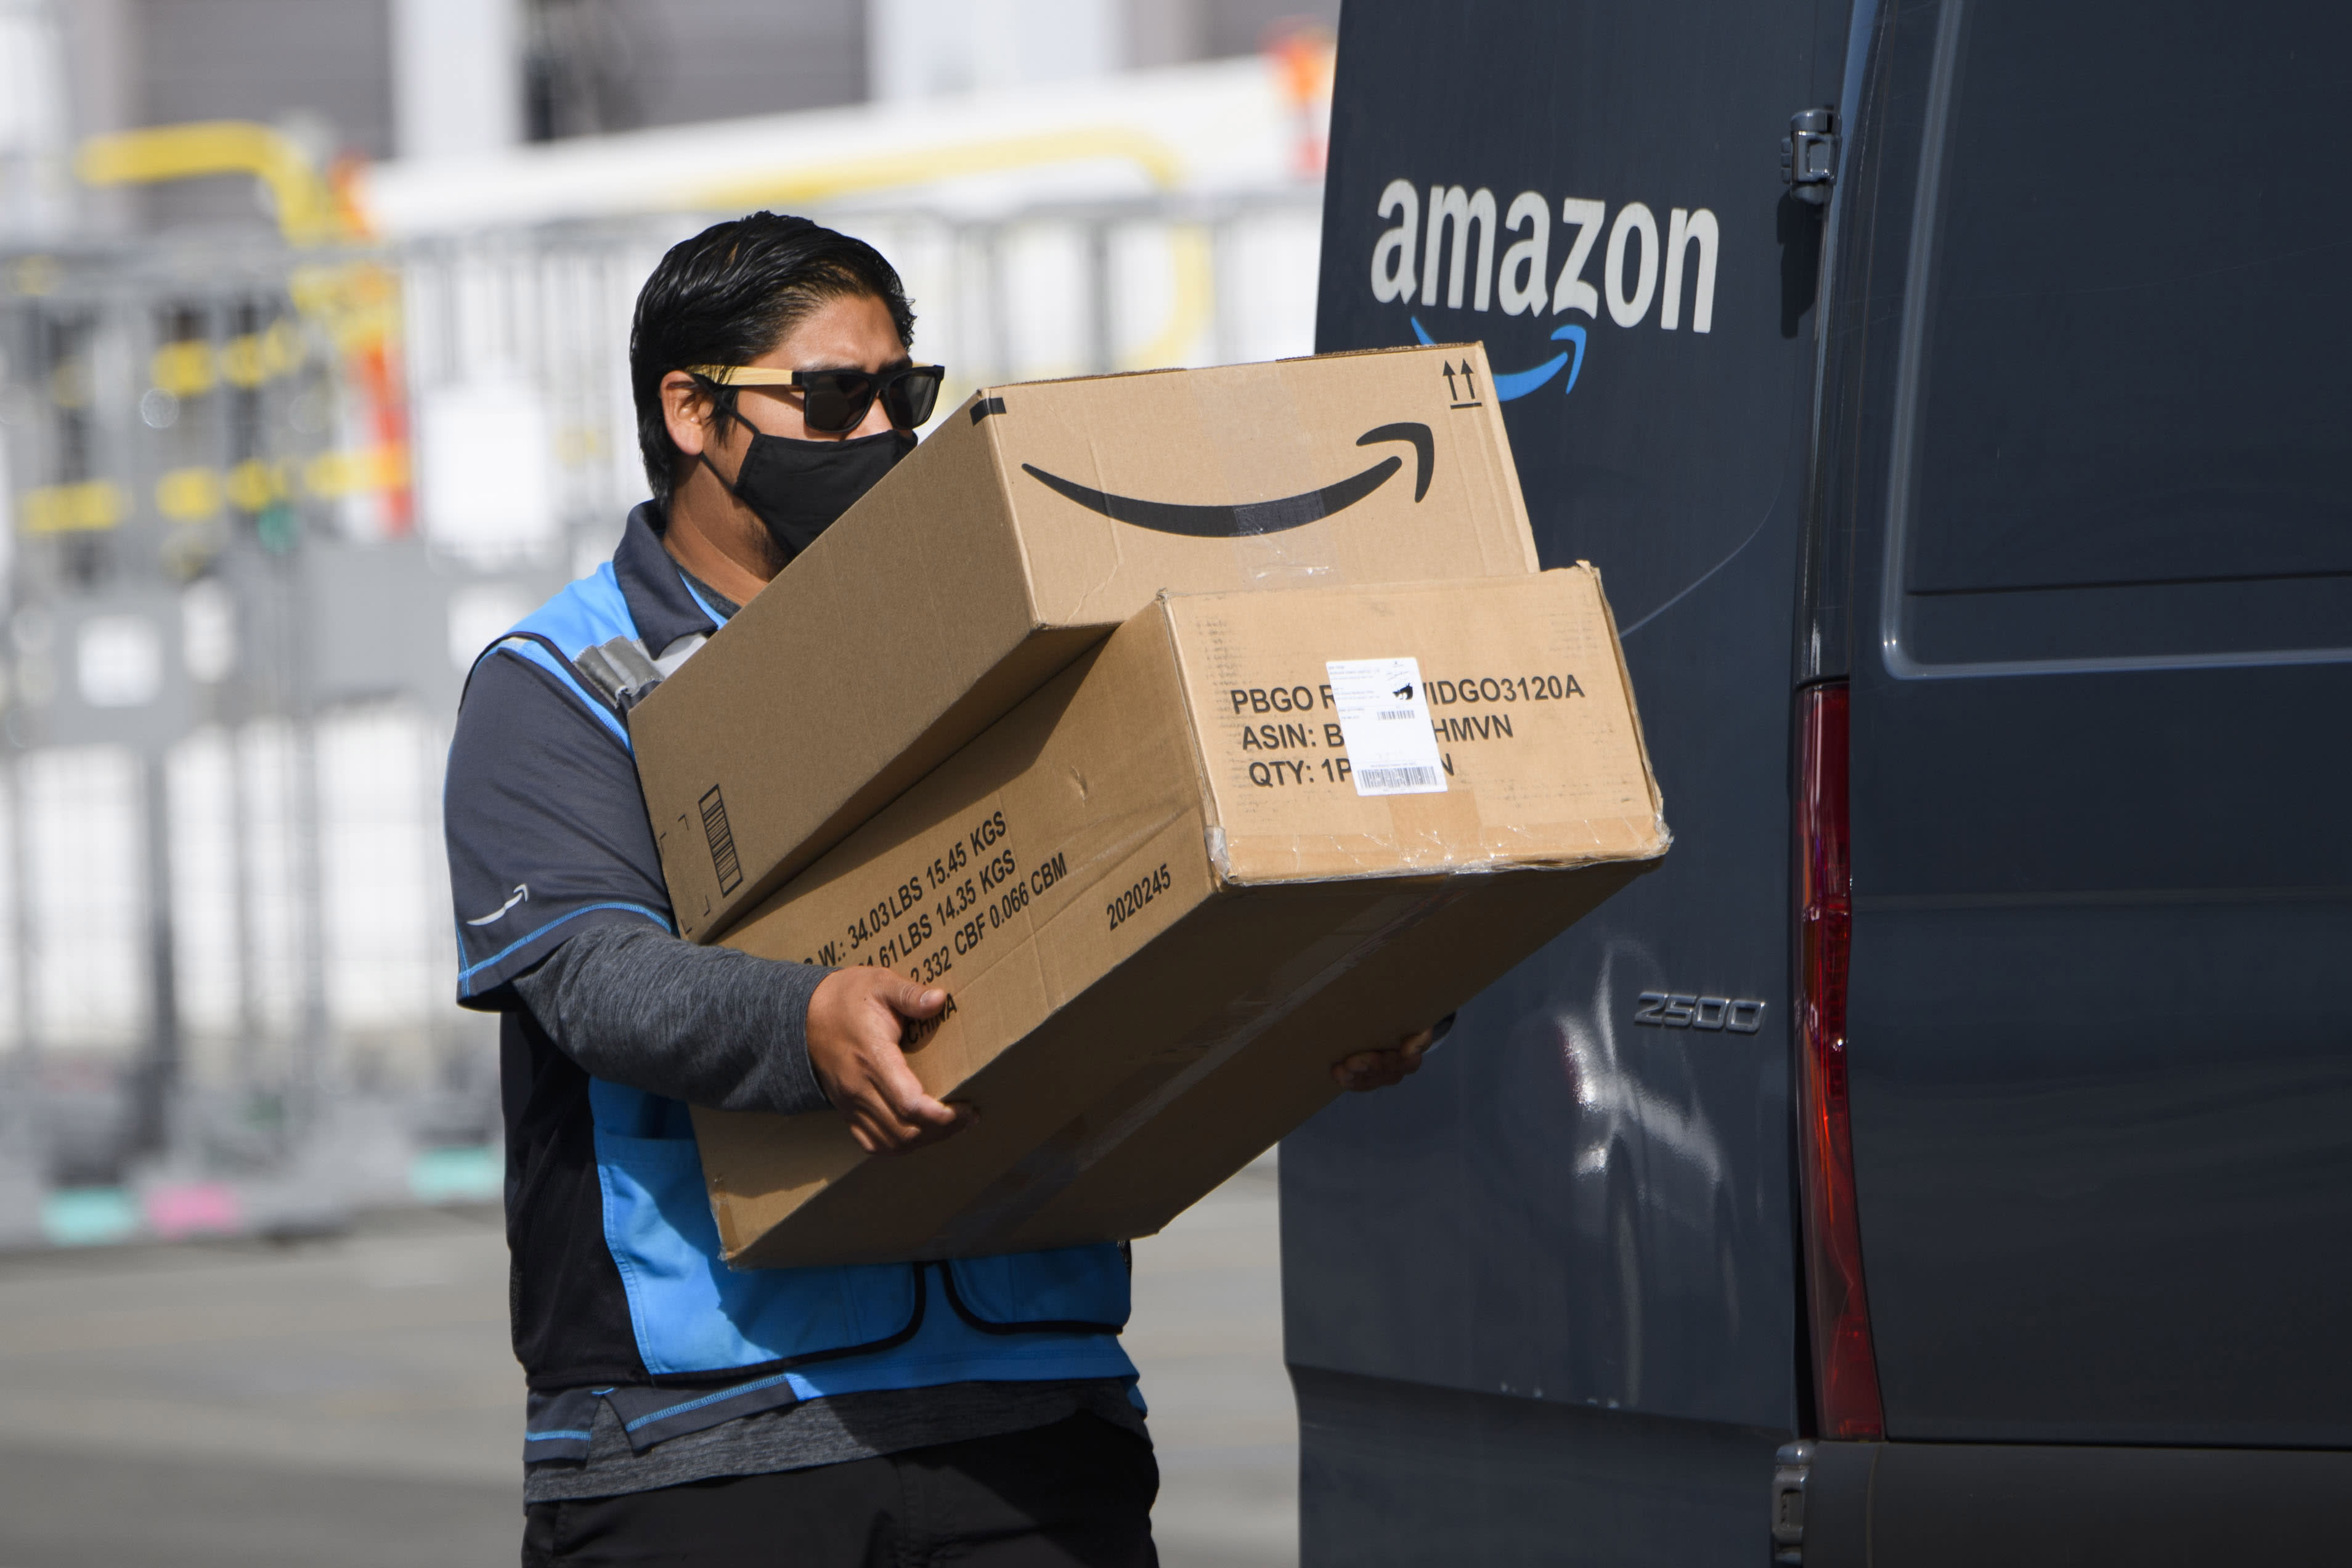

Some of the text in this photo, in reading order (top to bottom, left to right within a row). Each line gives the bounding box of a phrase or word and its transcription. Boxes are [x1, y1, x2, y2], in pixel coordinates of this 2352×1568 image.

[1371, 179, 1719, 333] amazon
[1231, 685, 1314, 715] PBGO
[1422, 674, 1585, 705] IDGO3120A
[1242, 723, 1316, 750] ASIN:
[1248, 760, 1314, 788] QTY:
[848, 902, 890, 949] 34.03
[888, 876, 923, 919] LBS
[926, 841, 967, 890] 15.45
[969, 811, 1006, 856] KGS
[898, 913, 932, 957] LBS
[936, 879, 976, 926] 14.35
[979, 849, 1015, 894] KGS
[954, 912, 986, 956] CBF
[989, 882, 1030, 929] 0.066
[1030, 852, 1067, 895] CBM
[1106, 863, 1171, 932] 2020245
[1634, 991, 1765, 1034] 2500
